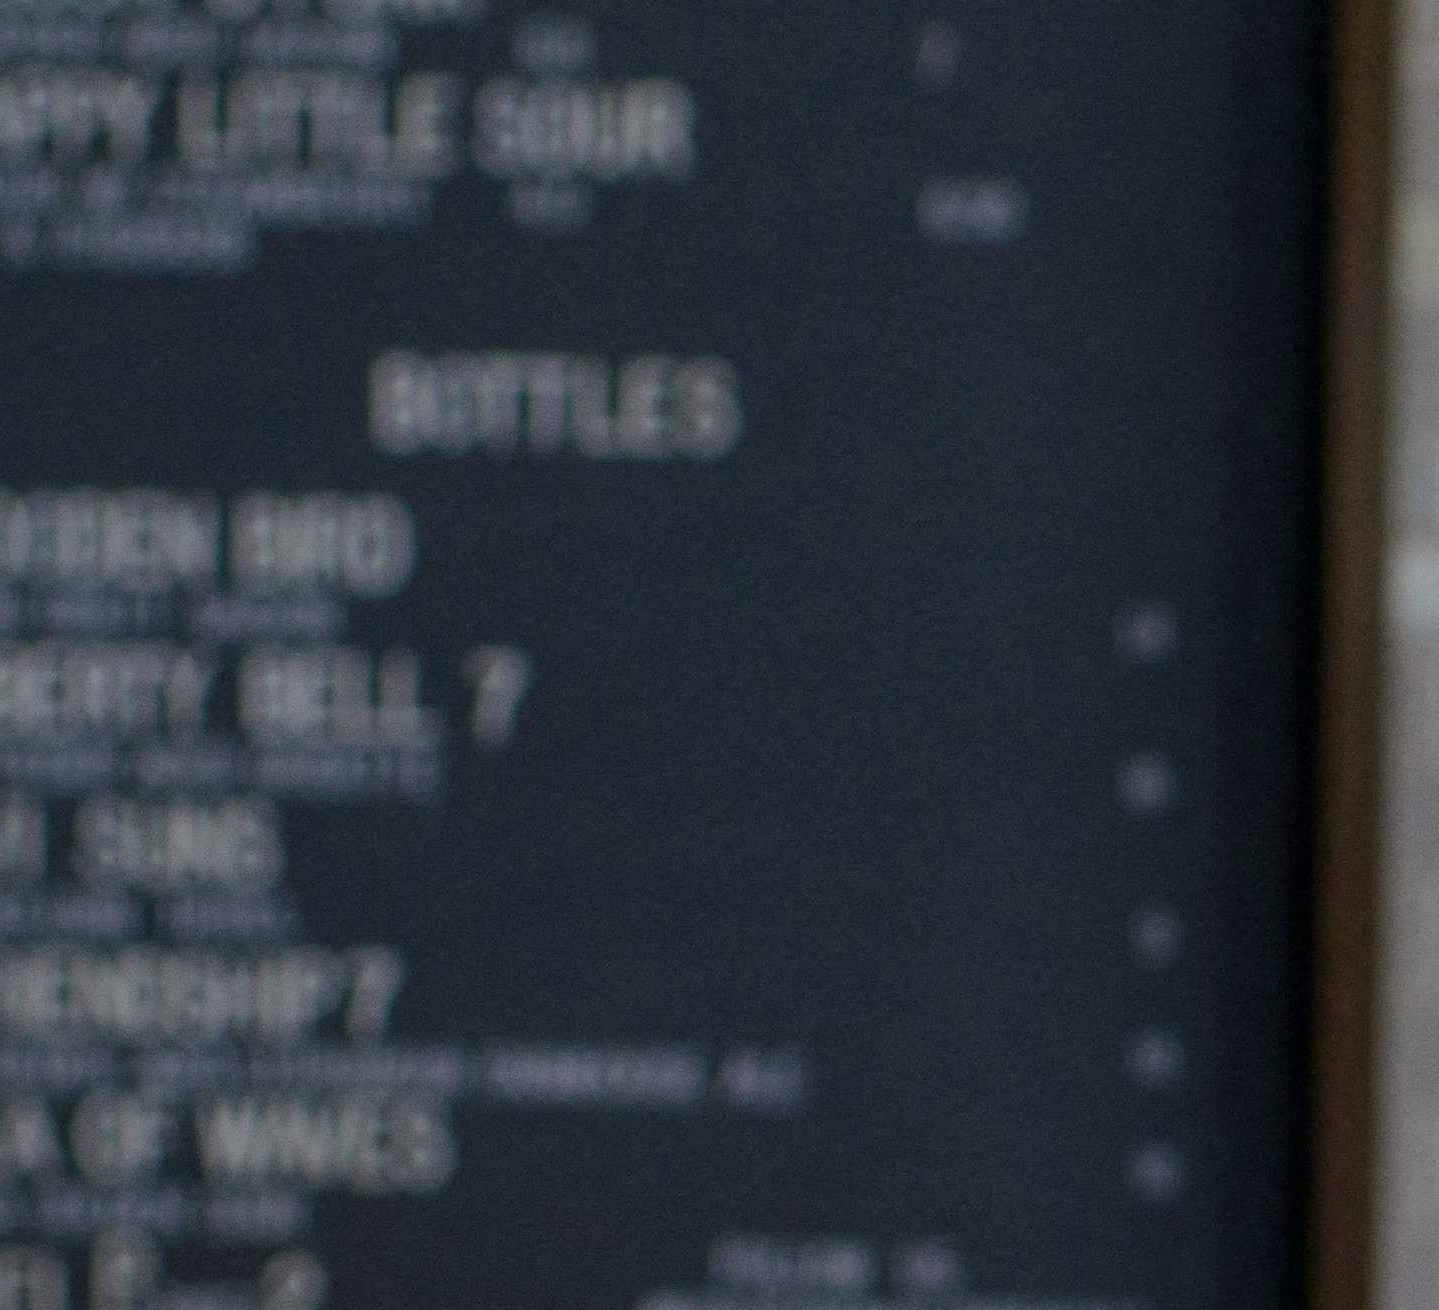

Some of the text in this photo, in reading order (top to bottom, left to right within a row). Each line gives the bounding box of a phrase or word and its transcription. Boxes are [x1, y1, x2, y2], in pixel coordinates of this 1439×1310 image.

[372, 359, 735, 453] BOTTLES
[245, 652, 441, 741] BELL
[78, 1095, 186, 1186] OF
[197, 1093, 452, 1189] WAVES
